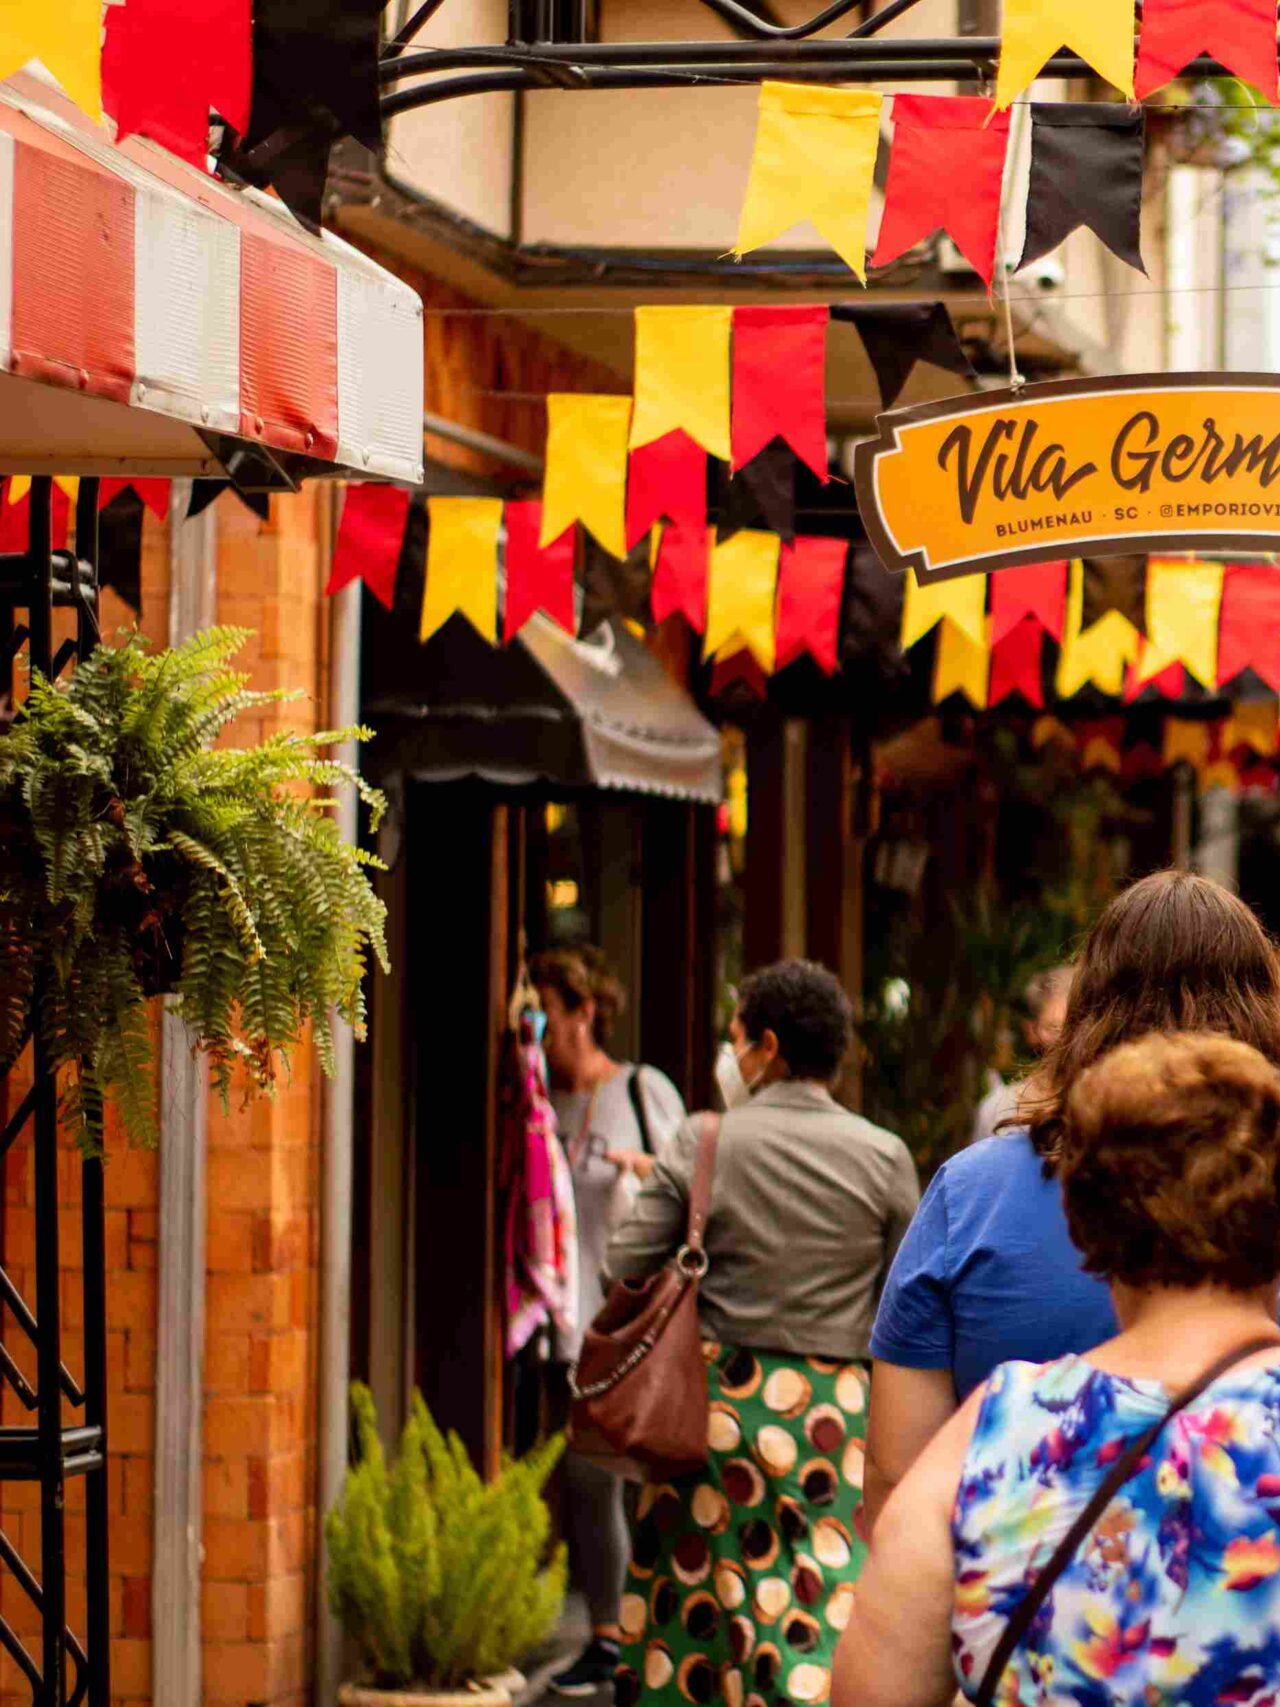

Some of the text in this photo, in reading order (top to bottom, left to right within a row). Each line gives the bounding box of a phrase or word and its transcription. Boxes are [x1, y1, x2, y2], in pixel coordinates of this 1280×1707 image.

[937, 419, 1098, 525] Vila
[996, 511, 1093, 537] BLUMENAU
[1114, 506, 1139, 520] SC
